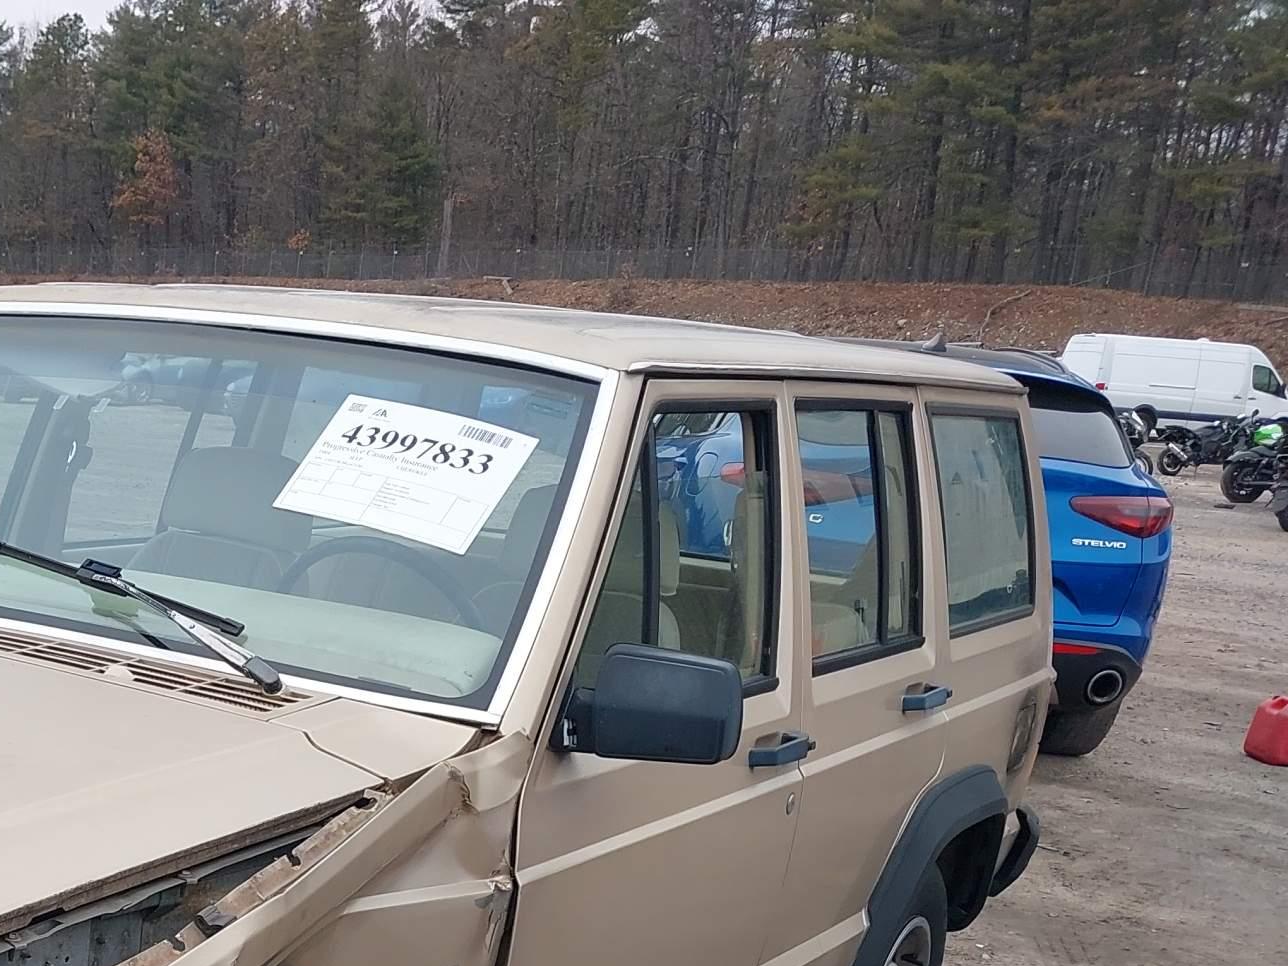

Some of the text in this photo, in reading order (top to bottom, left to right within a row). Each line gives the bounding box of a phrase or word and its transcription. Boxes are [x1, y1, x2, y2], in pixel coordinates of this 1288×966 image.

[322, 440, 366, 455] Progressive
[366, 450, 398, 464] Casualty
[400, 456, 438, 472] Insurance
[341, 424, 494, 475] 43997833
[1071, 538, 1127, 549] STELVIO
